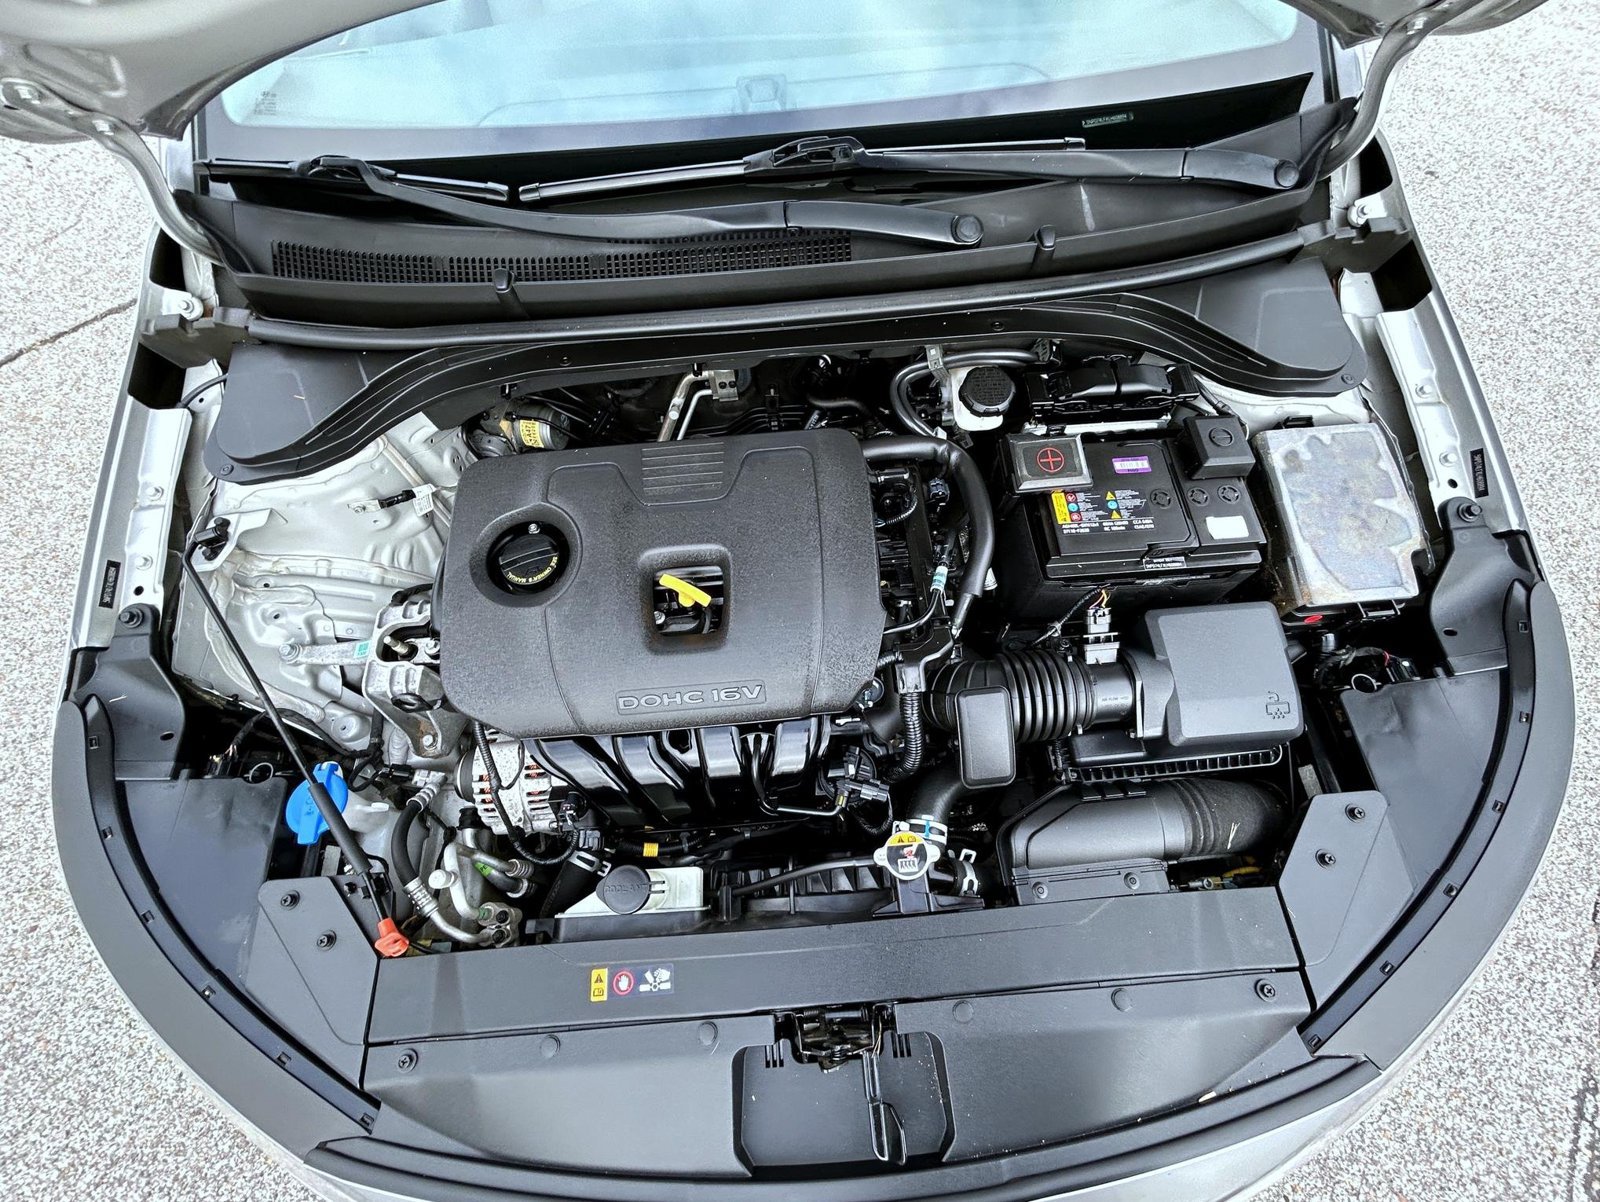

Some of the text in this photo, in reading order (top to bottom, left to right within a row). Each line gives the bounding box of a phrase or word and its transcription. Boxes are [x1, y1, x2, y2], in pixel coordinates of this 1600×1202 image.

[506, 571, 527, 583] MANUAL
[528, 566, 552, 583] OWNER'S
[617, 684, 763, 711] DOHC 16V
[603, 882, 648, 895] COOLANT
